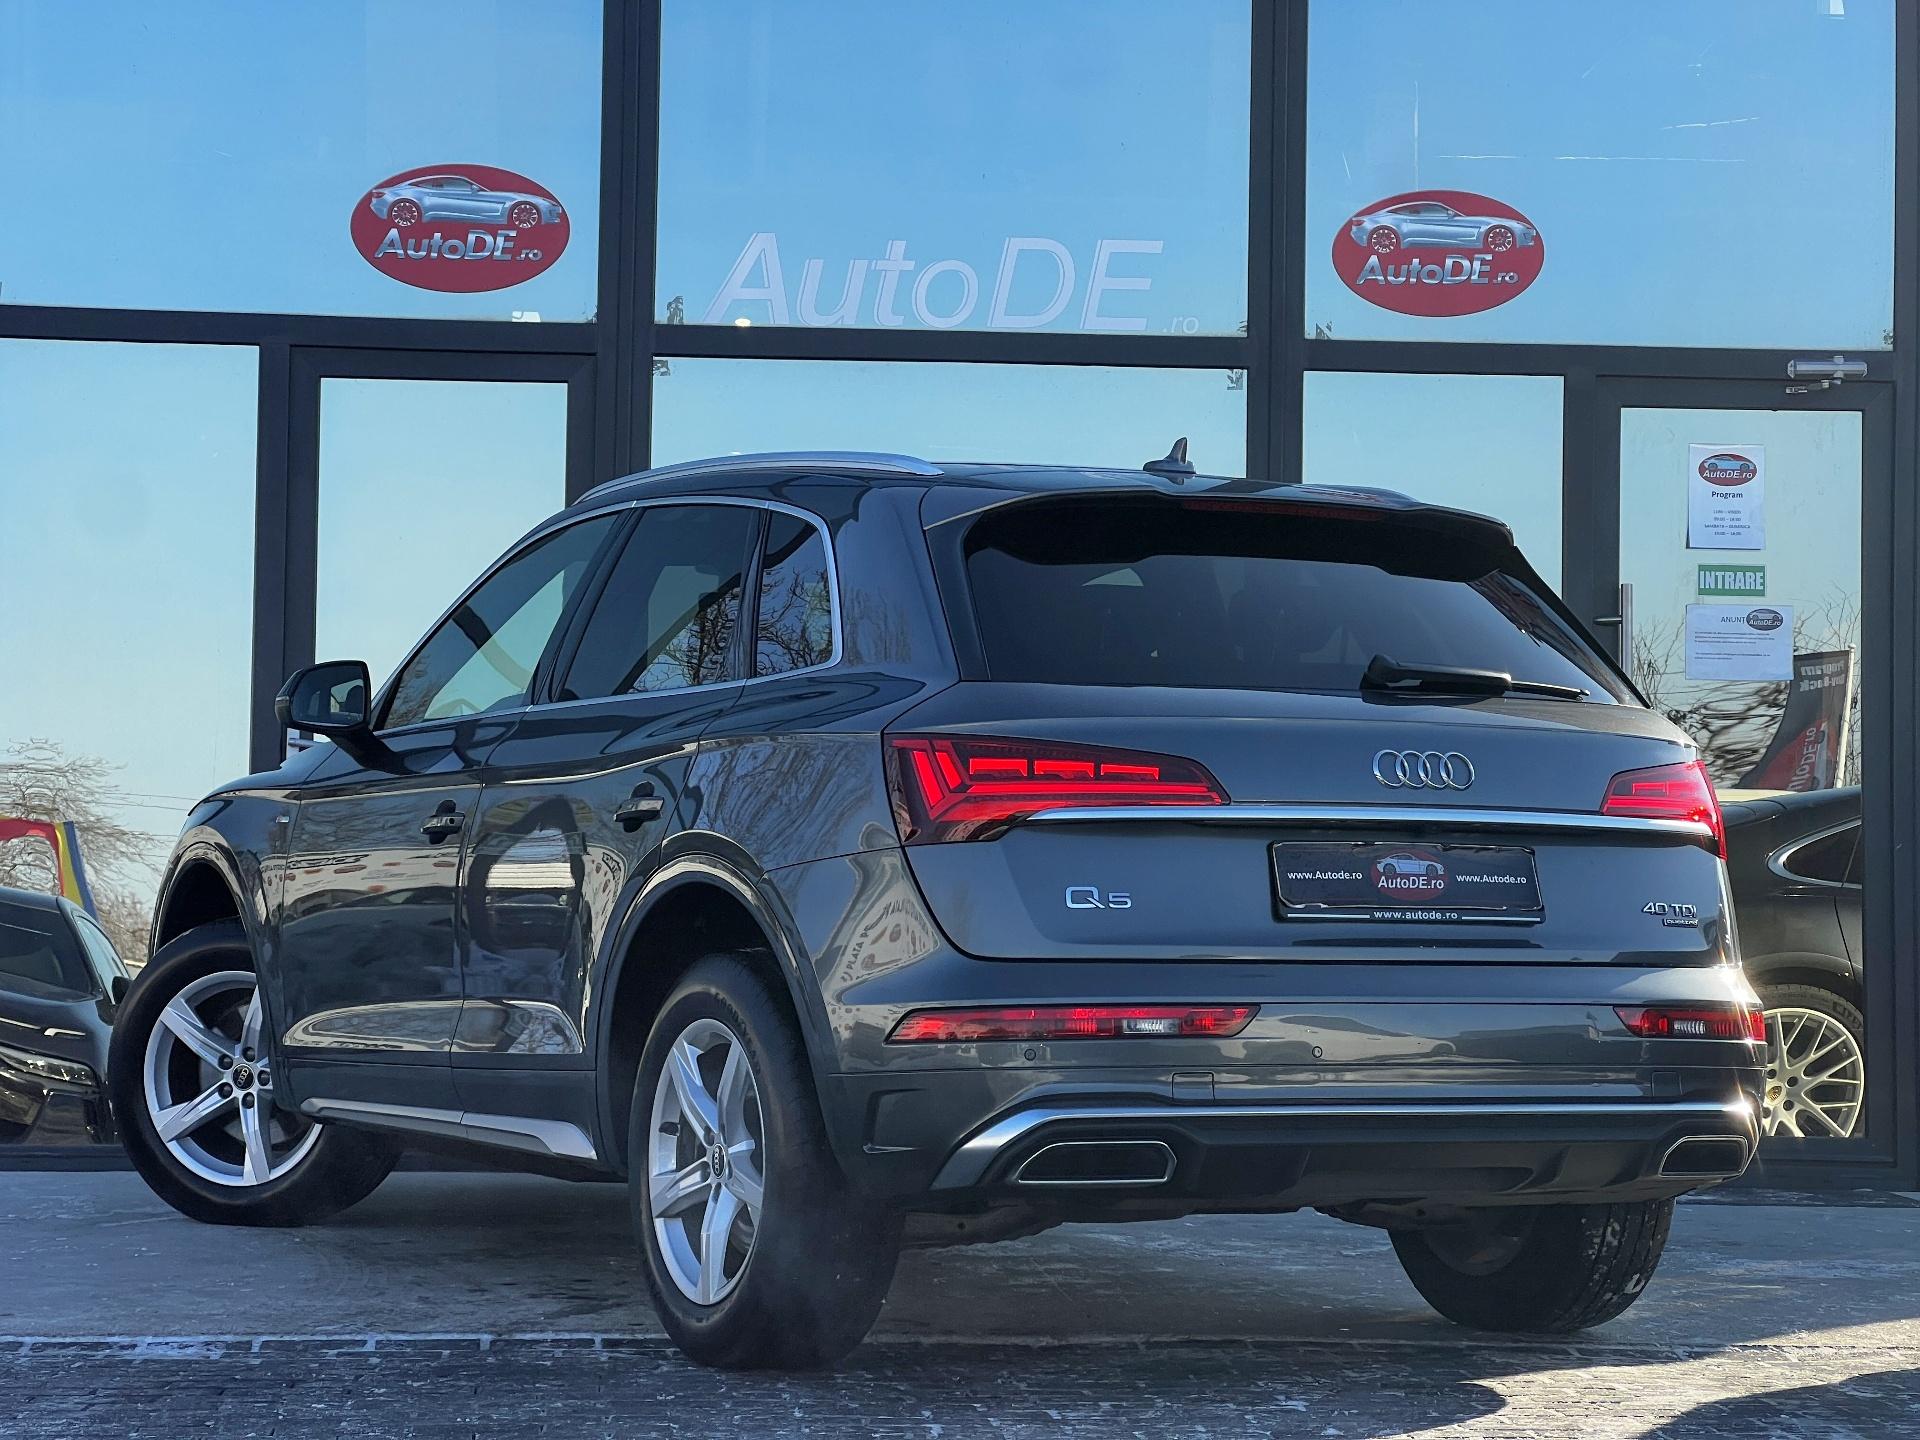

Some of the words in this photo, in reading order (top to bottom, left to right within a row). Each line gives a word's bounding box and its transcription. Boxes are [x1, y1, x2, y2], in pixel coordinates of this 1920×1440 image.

[1703, 470, 1753, 478] AutoDE.ro
[1711, 491, 1743, 499] Program
[1699, 571, 1764, 590] INTRARE
[1287, 870, 1363, 880] www.Autode.ro
[1455, 873, 1527, 884] www.Autode.ro
[1377, 876, 1445, 890] AutoDE.ro
[1065, 886, 1132, 909] Q5
[1373, 910, 1459, 920] www.autode.ro
[1642, 902, 1668, 914] 40
[1670, 903, 1697, 917] TDI
